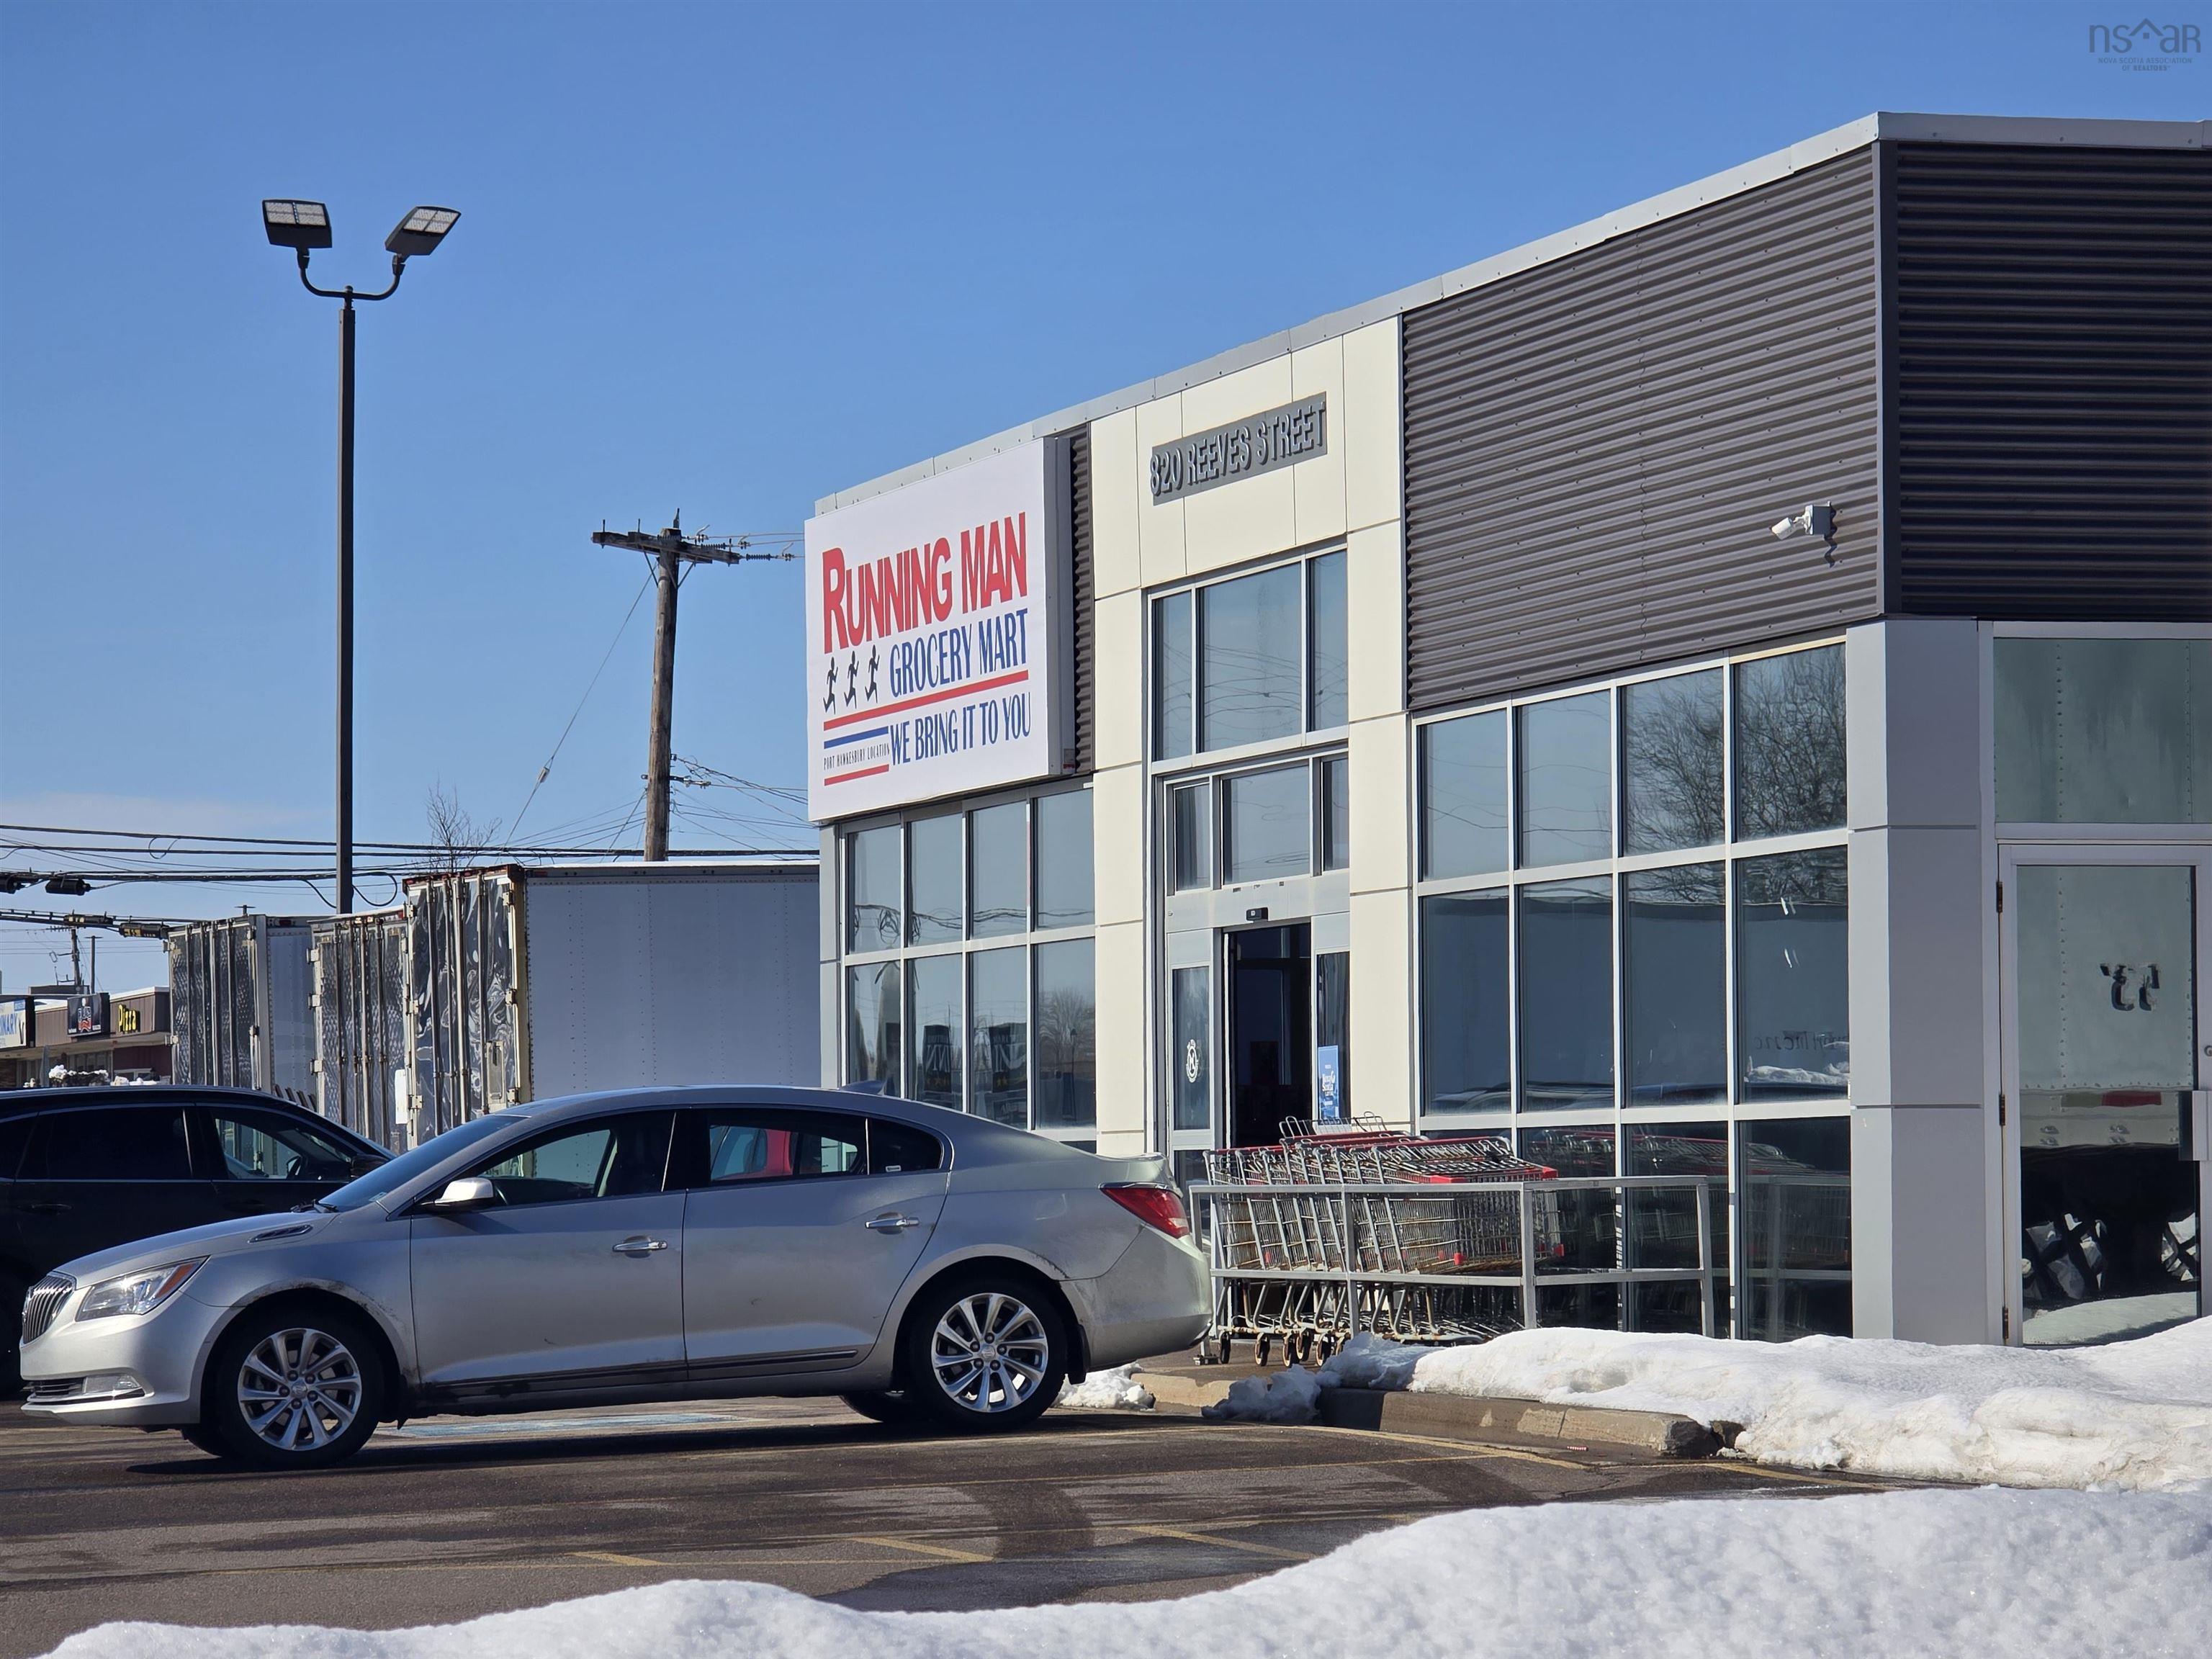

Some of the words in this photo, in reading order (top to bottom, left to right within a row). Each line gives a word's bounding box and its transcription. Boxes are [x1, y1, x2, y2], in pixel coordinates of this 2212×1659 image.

[1150, 448, 1183, 496] 820
[1188, 425, 1251, 487] REEVES
[1256, 400, 1326, 466] STREET
[961, 511, 1028, 614] MAN
[889, 623, 972, 698] GROCERY
[979, 608, 1028, 675] MART
[824, 755, 835, 770] PORT
[837, 748, 866, 767] HAWKESBURY
[867, 742, 890, 760] LOCATION
[890, 721, 911, 766] WE
[914, 709, 958, 761] BRING
[963, 704, 976, 750] IT
[979, 699, 999, 746] TO
[1002, 691, 1031, 741] YOU
